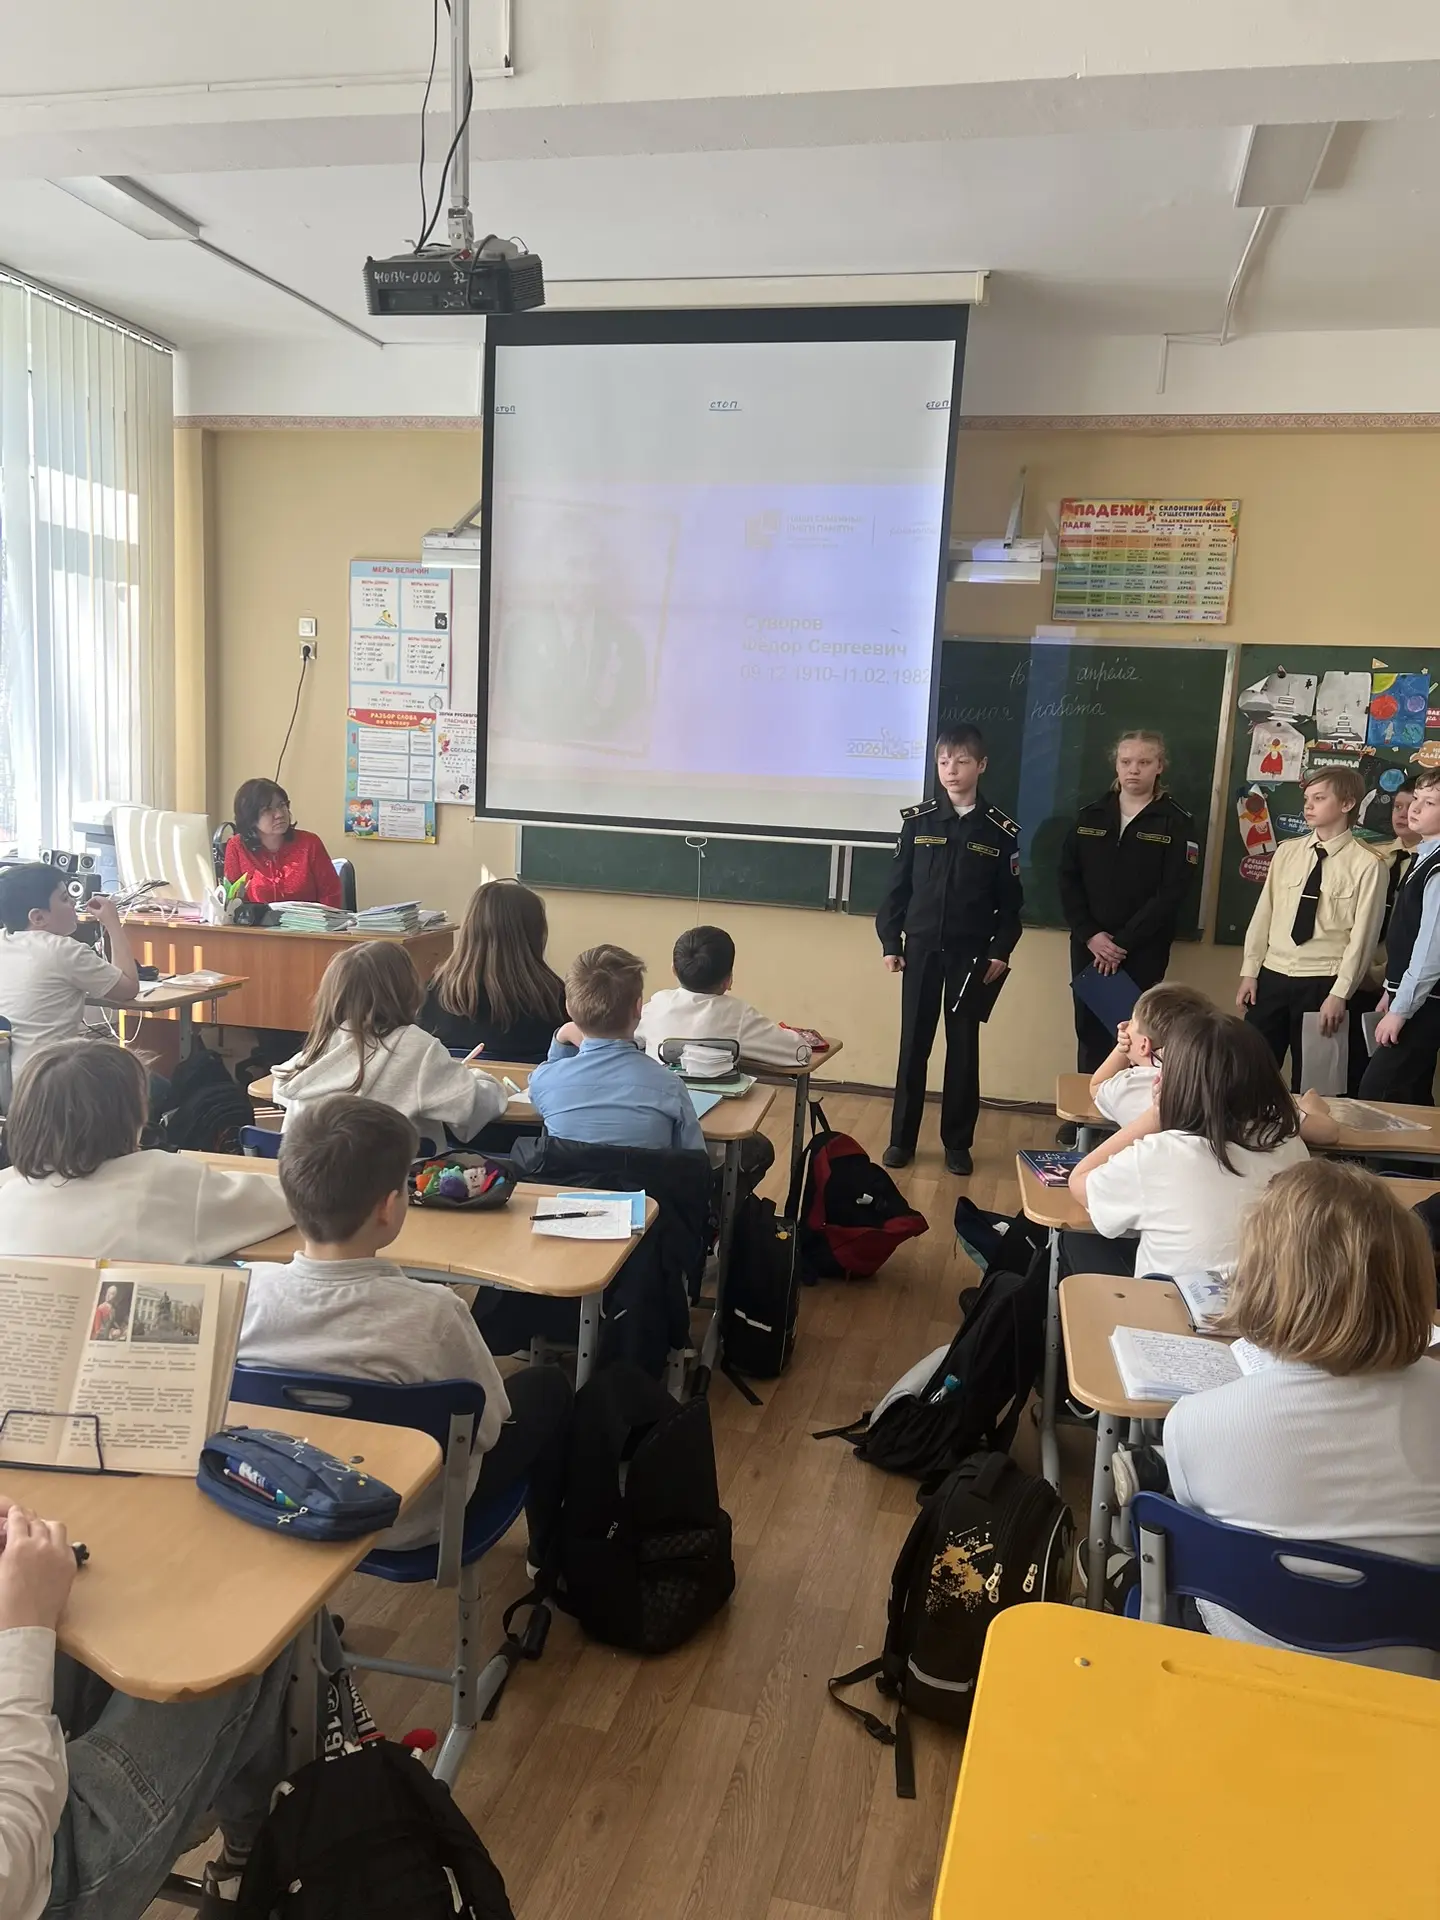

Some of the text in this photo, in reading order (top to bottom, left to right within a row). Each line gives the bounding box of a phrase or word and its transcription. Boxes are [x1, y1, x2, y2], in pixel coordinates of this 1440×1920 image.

[1075, 503, 1146, 518] ПАДЕЖИ
[1062, 521, 1092, 529] ПАДЕЖ
[395, 567, 430, 575] ВЕЛИЧИН
[744, 615, 823, 634] Суворов
[808, 639, 907, 657] Сергеевич
[1009, 659, 1033, 690] 16
[940, 694, 1015, 721] лассная
[370, 712, 396, 720] РАЗБОР
[846, 742, 881, 755] 2026
[1314, 758, 1360, 769] ПРАВИЛА
[1244, 863, 1269, 871] ВОПРО
